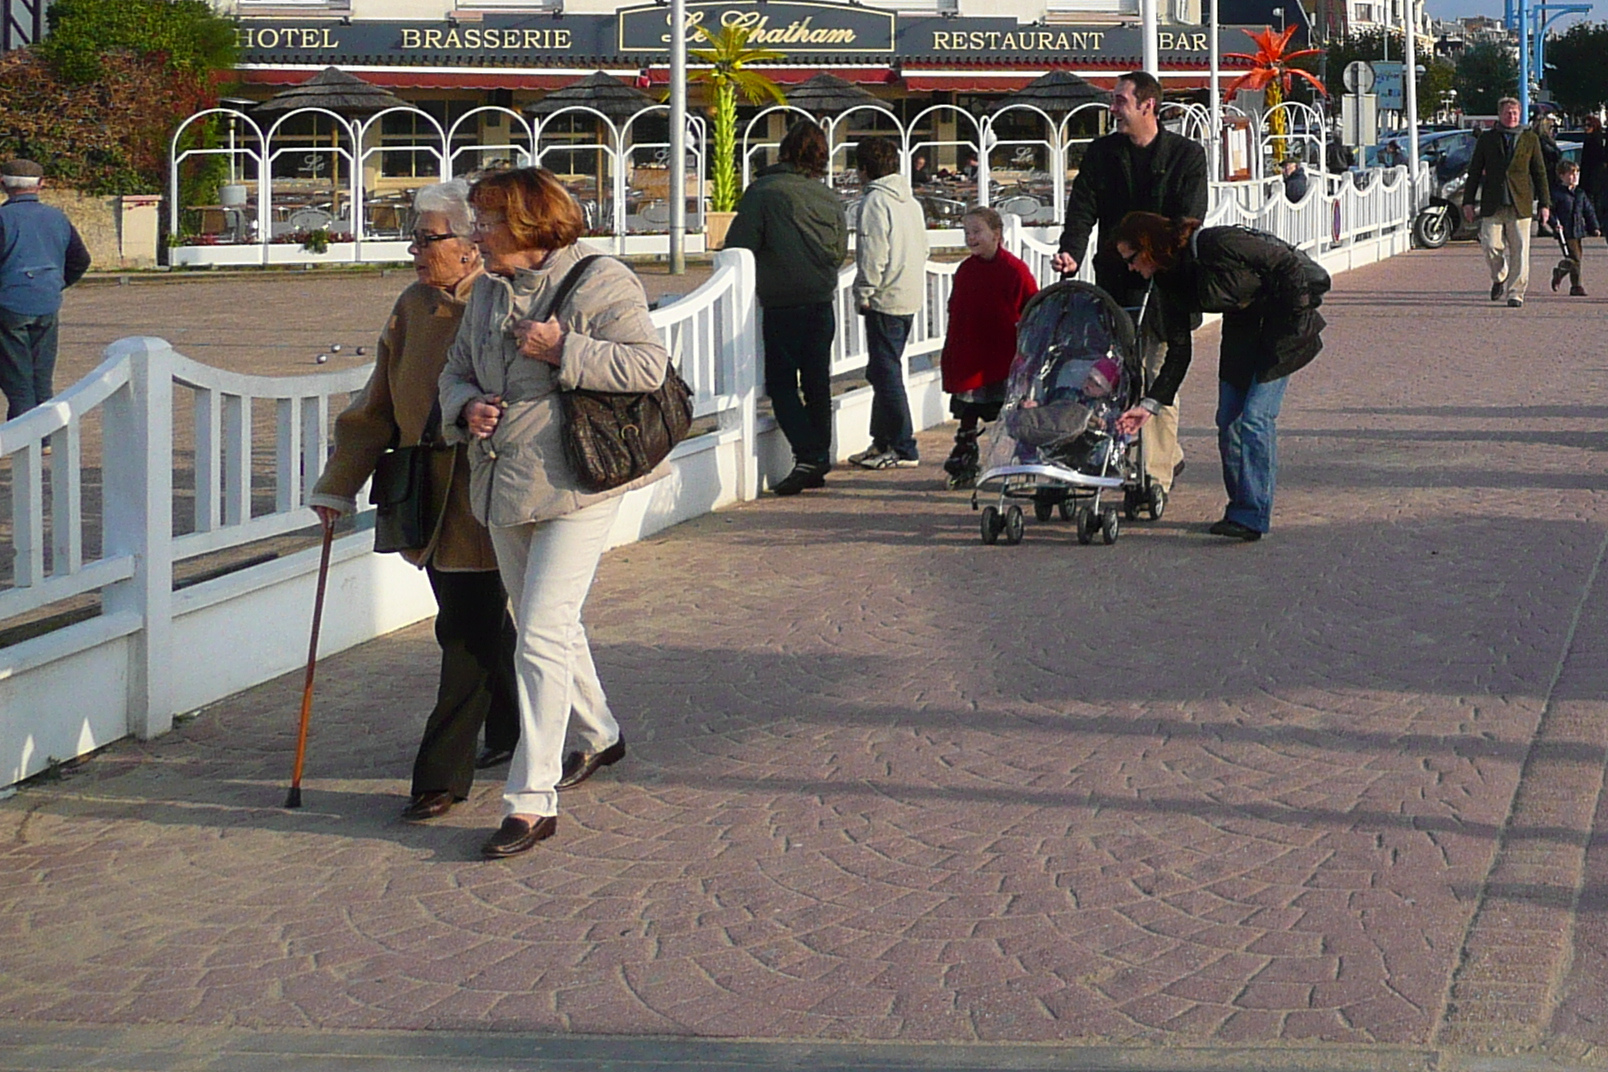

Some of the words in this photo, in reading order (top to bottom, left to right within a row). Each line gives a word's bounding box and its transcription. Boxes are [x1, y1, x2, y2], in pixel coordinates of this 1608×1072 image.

[720, 10, 857, 44] Chatham
[234, 29, 340, 49] HOTEL
[400, 29, 573, 50] BRASSERIE
[932, 31, 1105, 51] RESTAURANT
[1157, 32, 1209, 52] BAR
